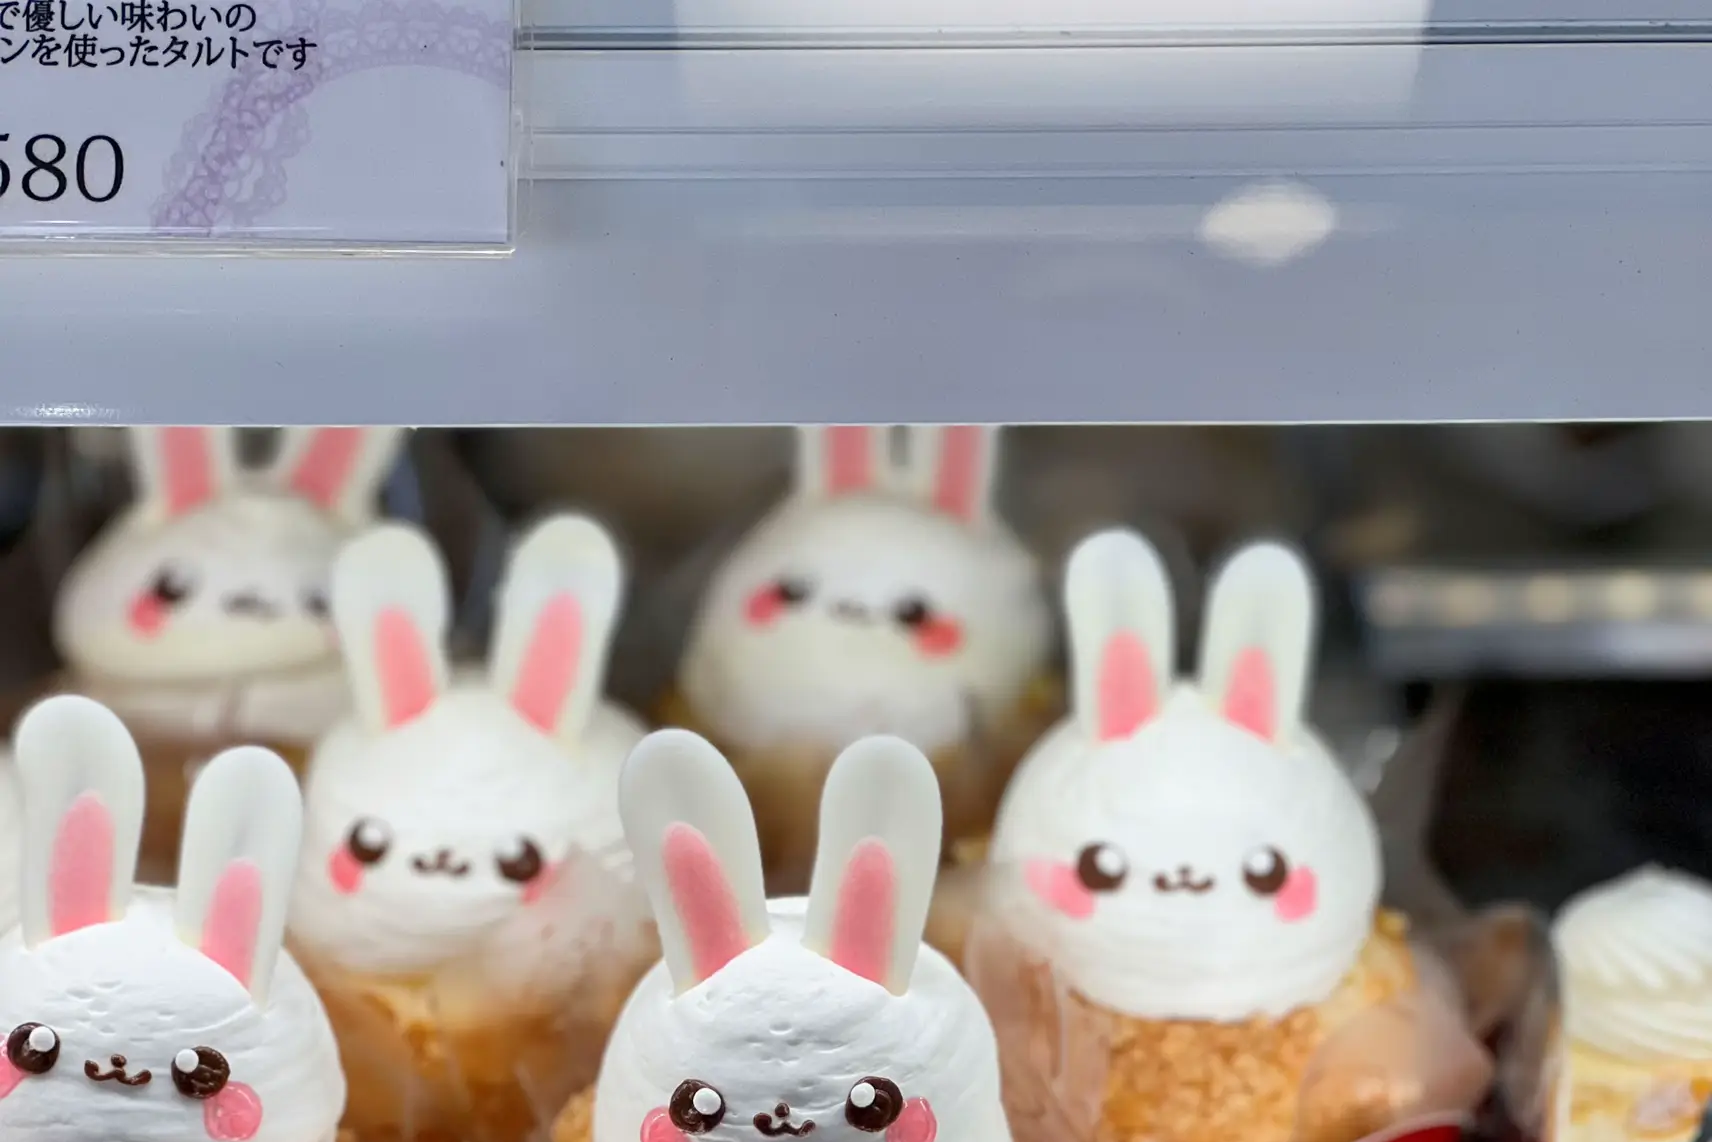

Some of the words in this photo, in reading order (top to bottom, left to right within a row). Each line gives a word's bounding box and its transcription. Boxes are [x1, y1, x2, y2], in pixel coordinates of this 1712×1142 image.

[0, 0, 257, 33] で優しい味わいの
[0, 34, 318, 70] ンを使ったタルトです
